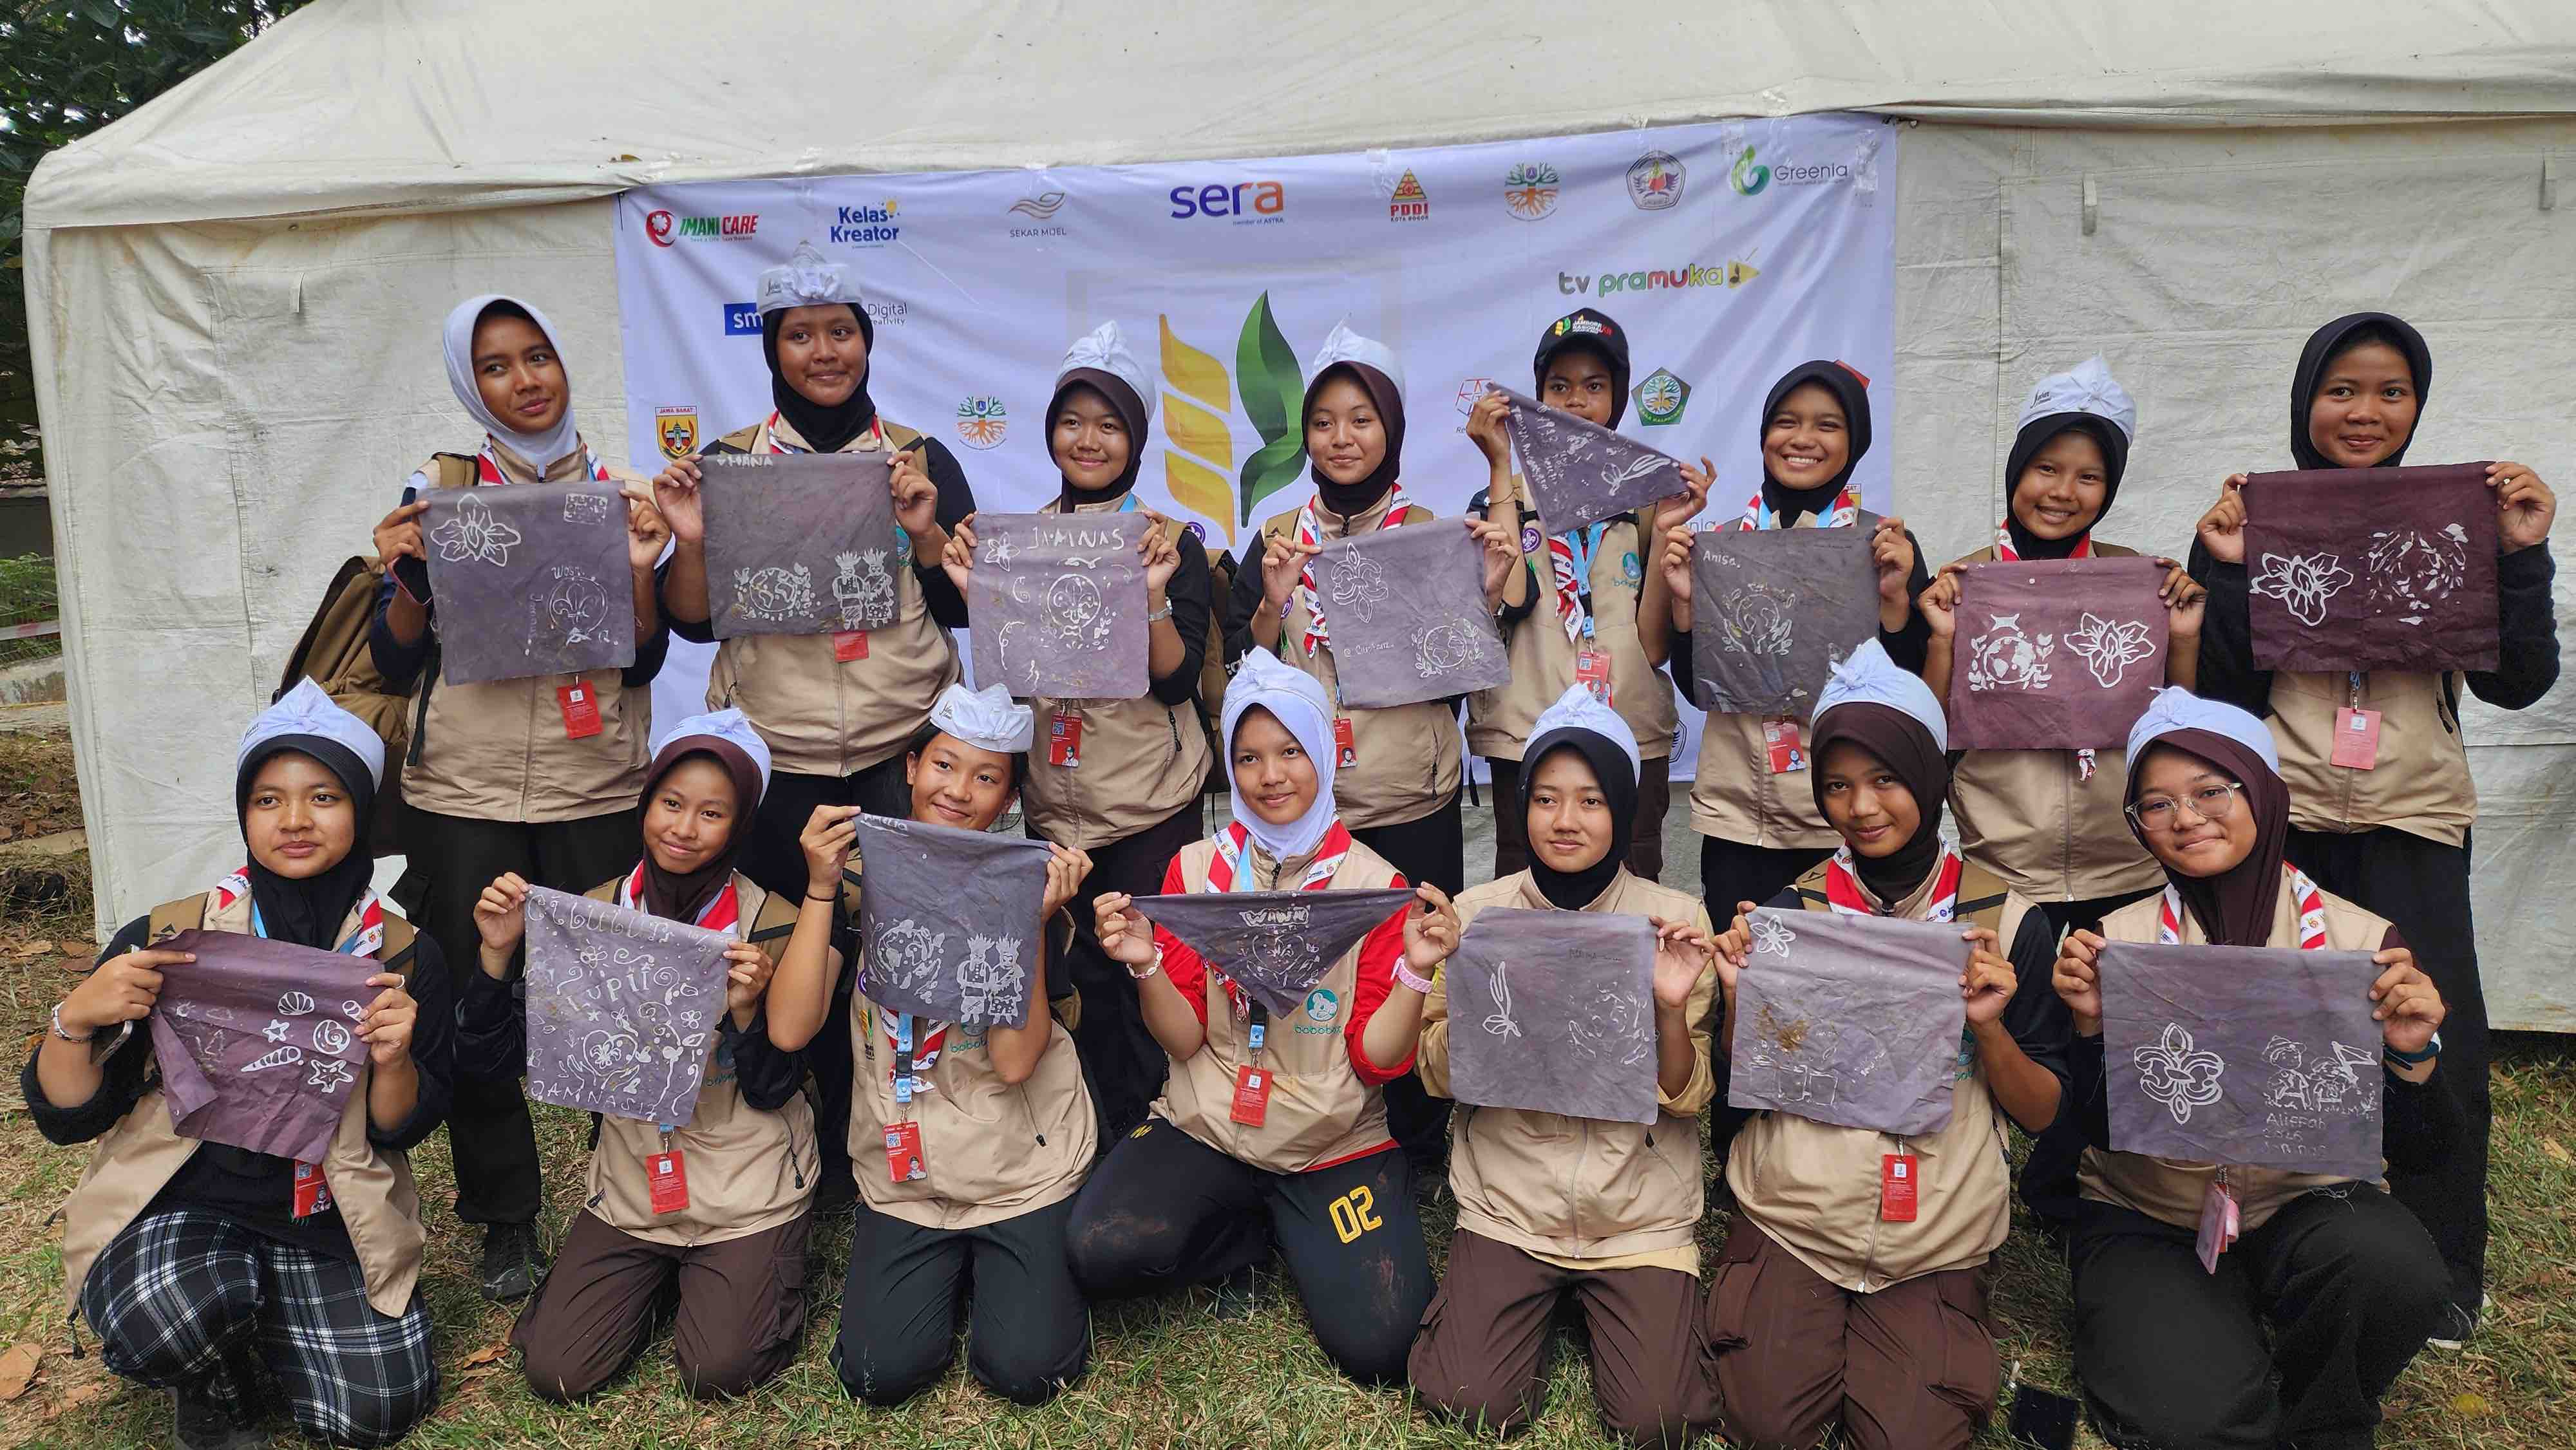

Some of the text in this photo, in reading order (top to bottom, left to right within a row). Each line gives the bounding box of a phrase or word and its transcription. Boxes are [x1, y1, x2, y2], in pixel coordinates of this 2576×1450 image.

[1170, 181, 1283, 219] sera
[838, 205, 888, 224] Kelas
[679, 215, 759, 236] IMANI CARE
[830, 225, 900, 243] Kreator
[1009, 229, 1039, 238] SEKAR
[1558, 263, 1723, 298] tv pramuka
[867, 303, 907, 319] Digital
[1329, 1185, 1383, 1244] 02
